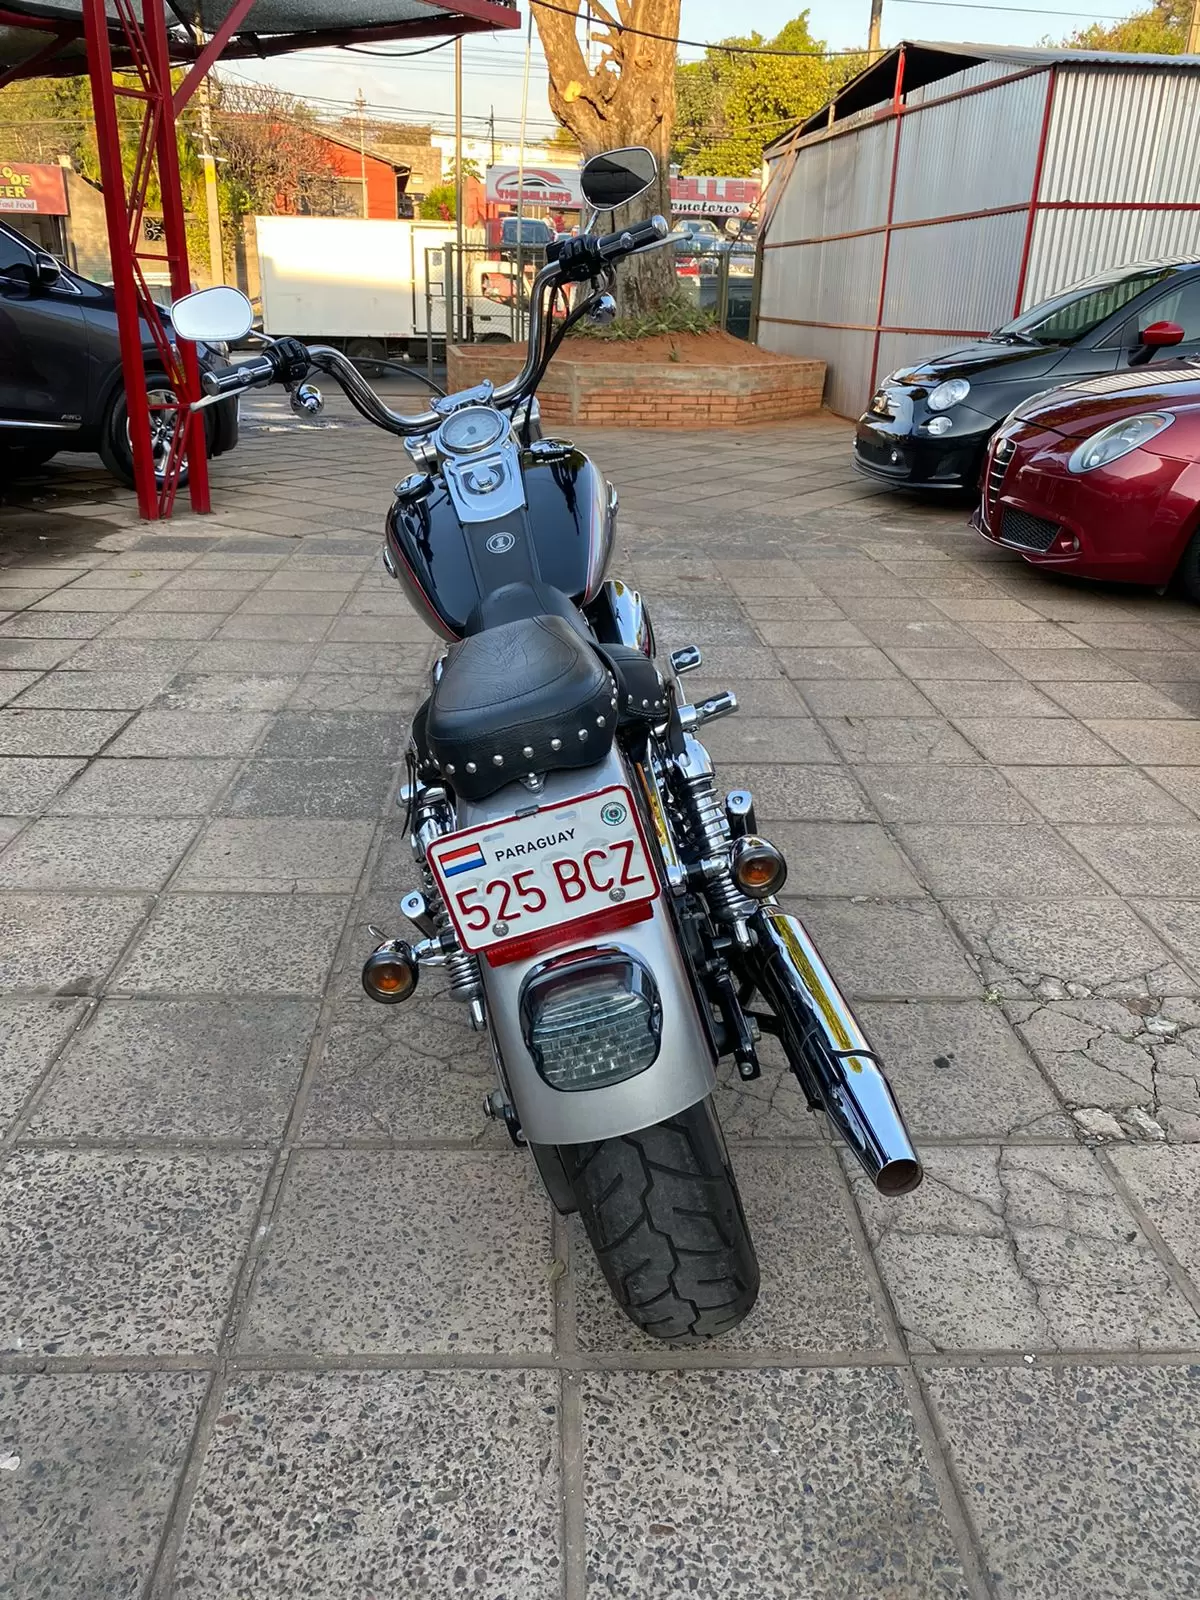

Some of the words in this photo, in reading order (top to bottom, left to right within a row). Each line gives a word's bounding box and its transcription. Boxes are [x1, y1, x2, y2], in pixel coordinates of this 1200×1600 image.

[495, 828, 576, 862] PARAGUAY
[455, 869, 547, 931] 525
[552, 840, 645, 903] BCZ
